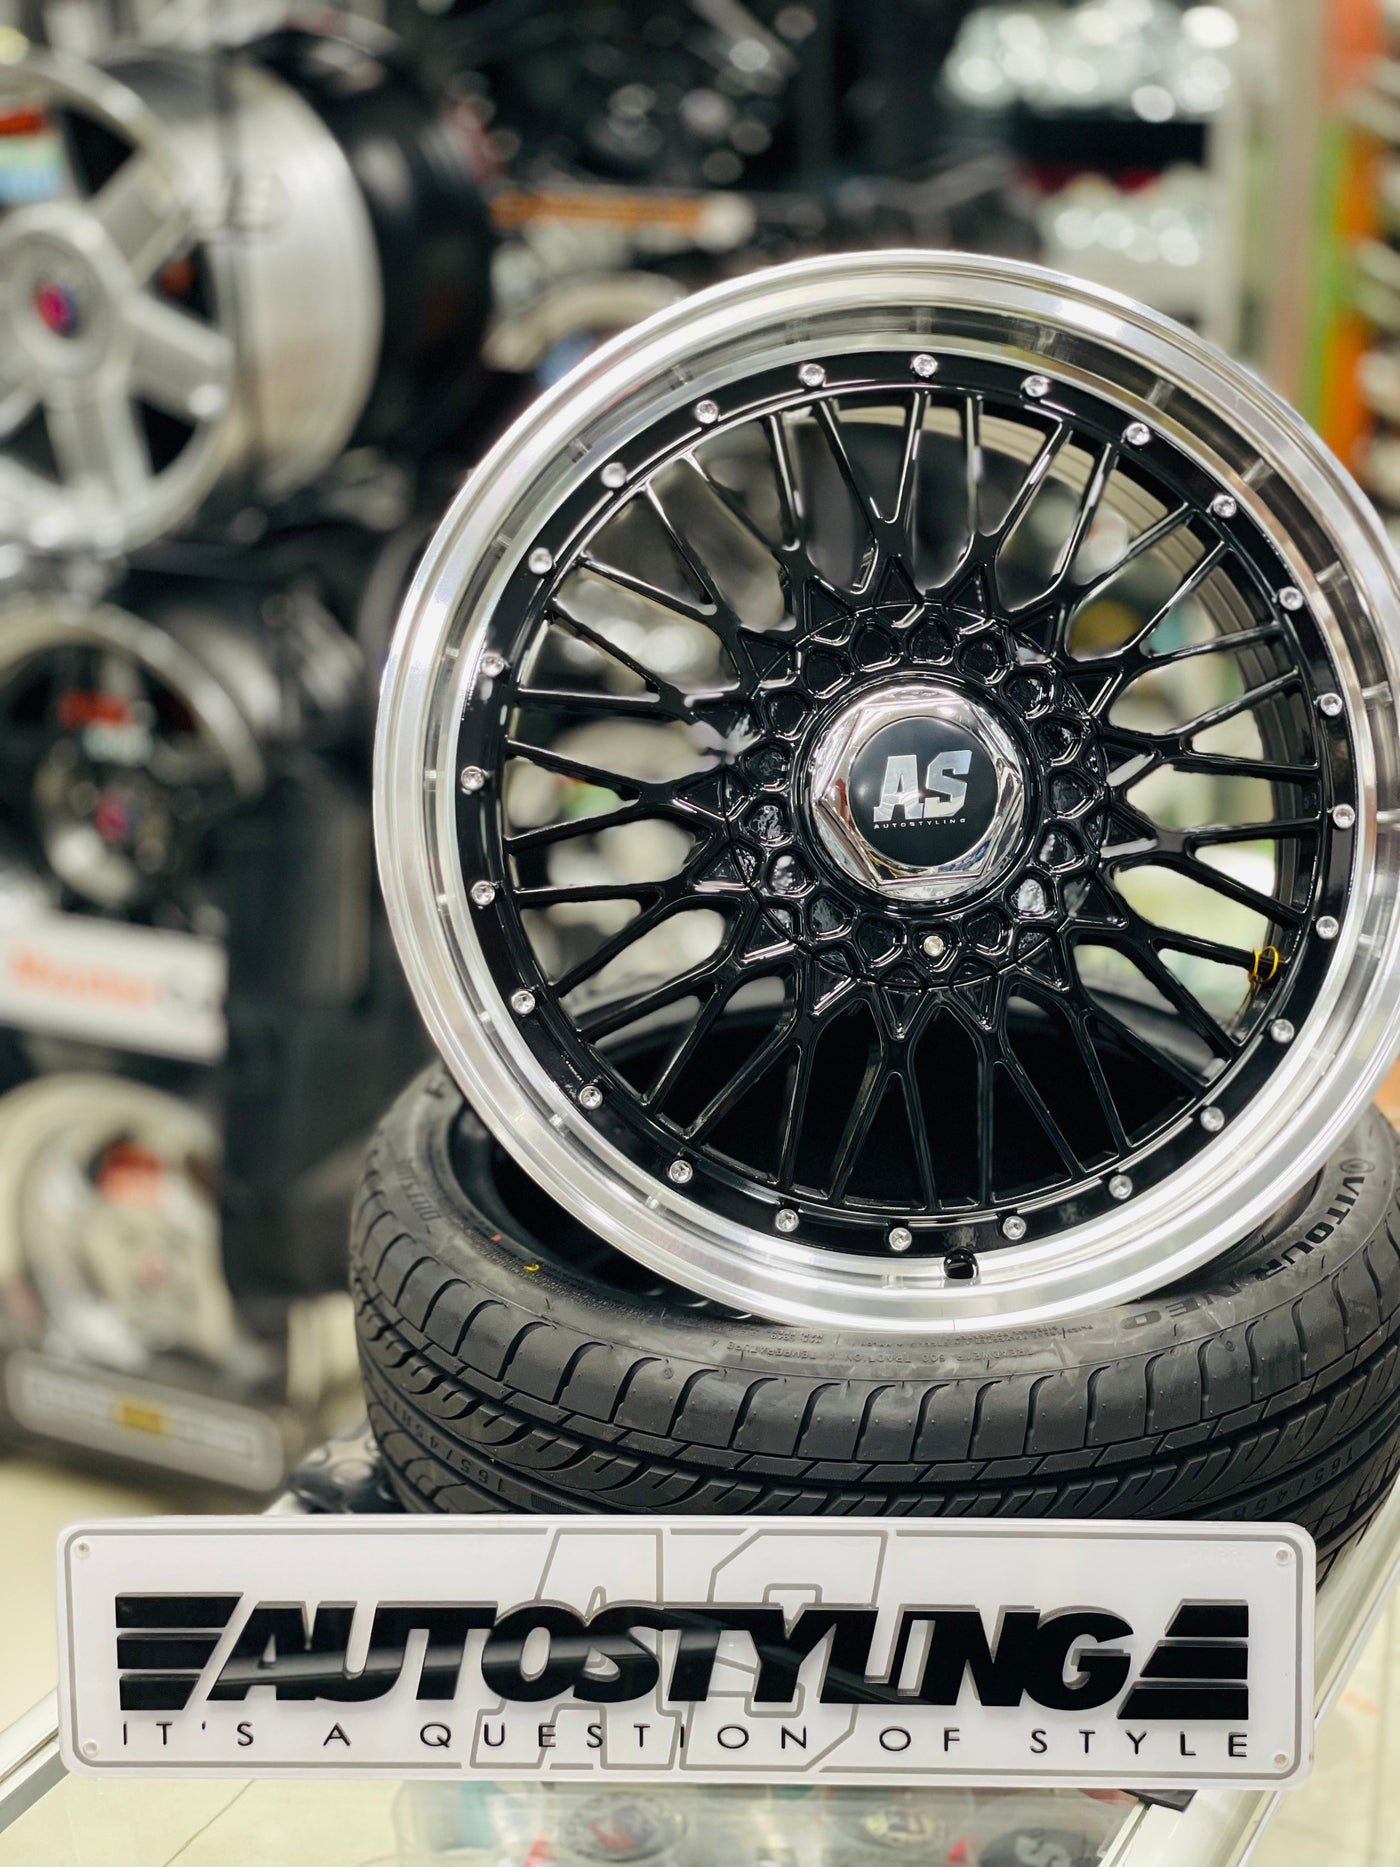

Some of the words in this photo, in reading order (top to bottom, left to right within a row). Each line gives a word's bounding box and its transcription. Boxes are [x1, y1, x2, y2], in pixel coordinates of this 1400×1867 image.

[874, 750, 972, 822] AS
[874, 818, 966, 829] AUTOSTYLING
[1249, 1176, 1365, 1282] VITOUR
[727, 1341, 817, 1360] TEMPERATURE
[207, 1599, 1135, 1711] AUTOSTYLING
[122, 1721, 255, 1748] IT'S
[323, 1722, 353, 1748] A
[420, 1722, 808, 1750] QUESTION
[879, 1727, 961, 1753] OF
[1030, 1728, 1249, 1759] STYLE
